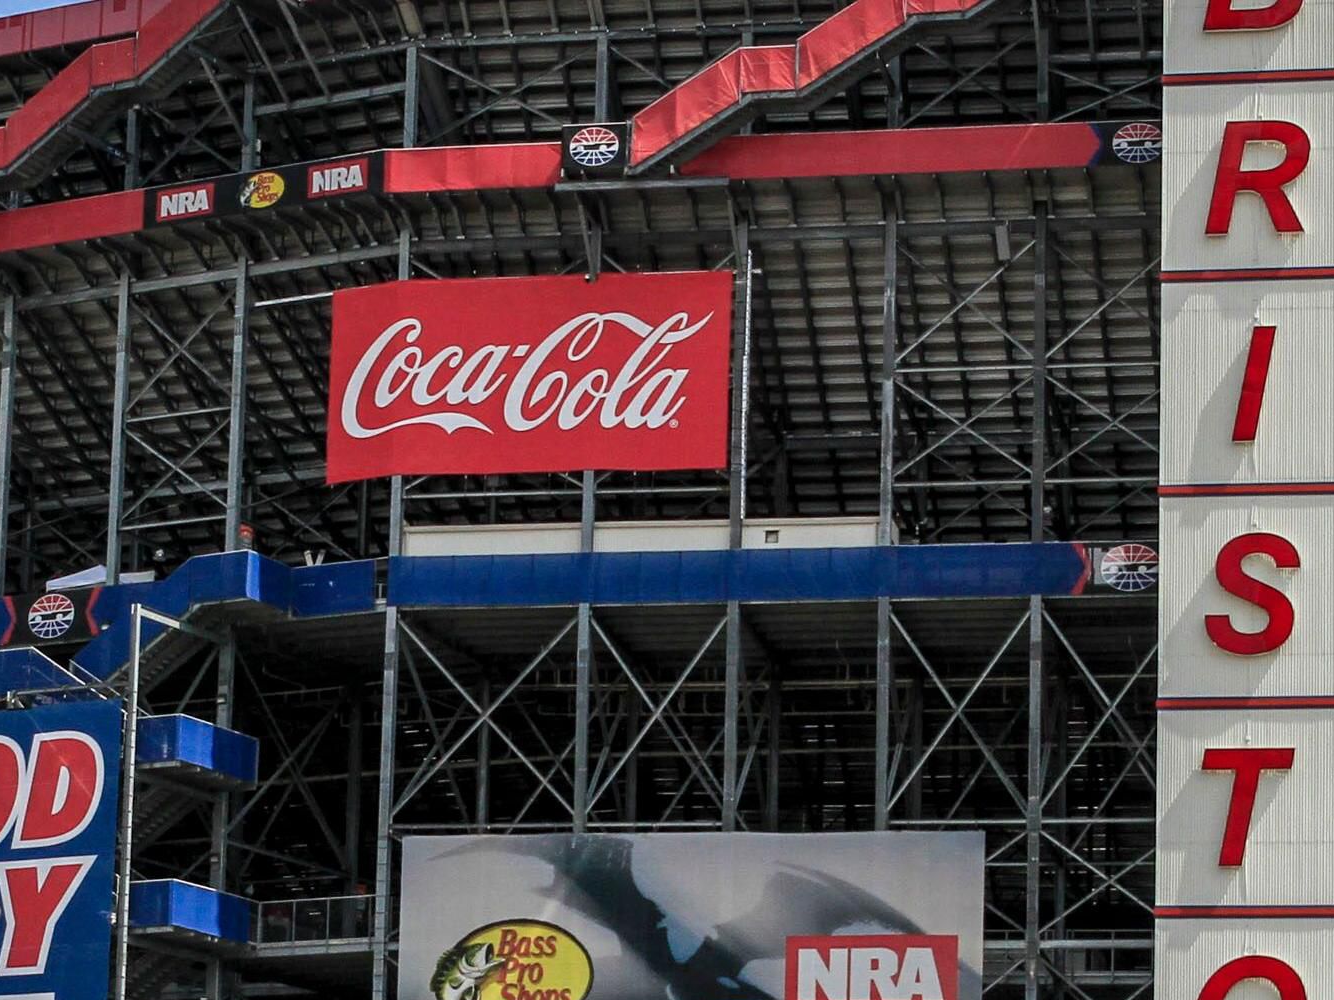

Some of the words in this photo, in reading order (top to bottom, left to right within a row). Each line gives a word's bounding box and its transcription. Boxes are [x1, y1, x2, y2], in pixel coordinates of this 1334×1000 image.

[312, 165, 363, 193] NRA
[160, 189, 209, 217] NRA
[341, 310, 714, 439] Coca-Cola
[496, 929, 558, 958] Bass
[500, 958, 543, 985] Pro
